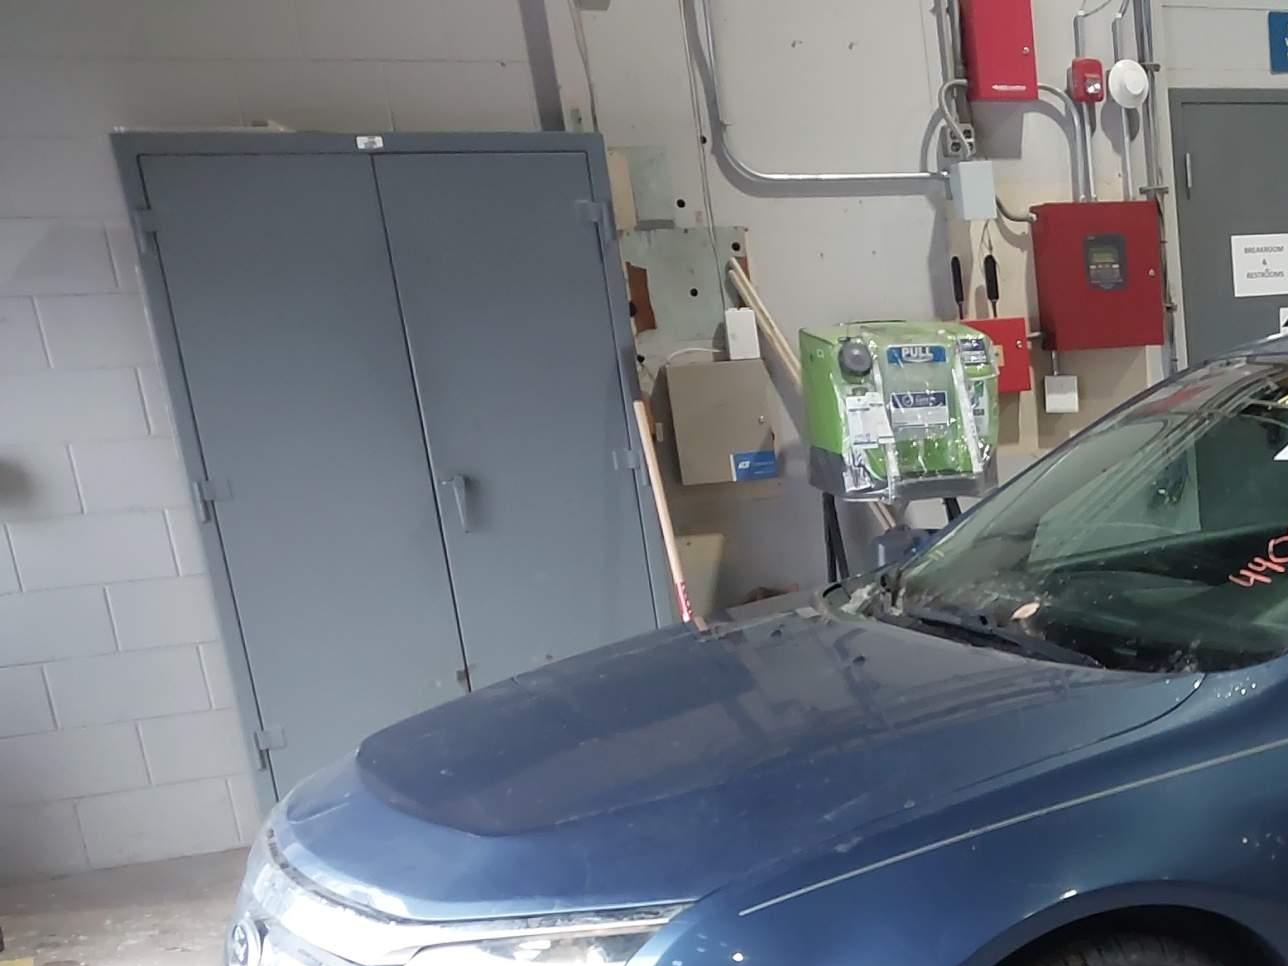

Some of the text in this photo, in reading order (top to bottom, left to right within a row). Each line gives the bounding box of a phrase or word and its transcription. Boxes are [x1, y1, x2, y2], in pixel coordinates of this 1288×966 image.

[1244, 246, 1284, 254] BREAKROOM
[1246, 271, 1284, 279] RESTROOMS
[902, 346, 933, 357] PULL
